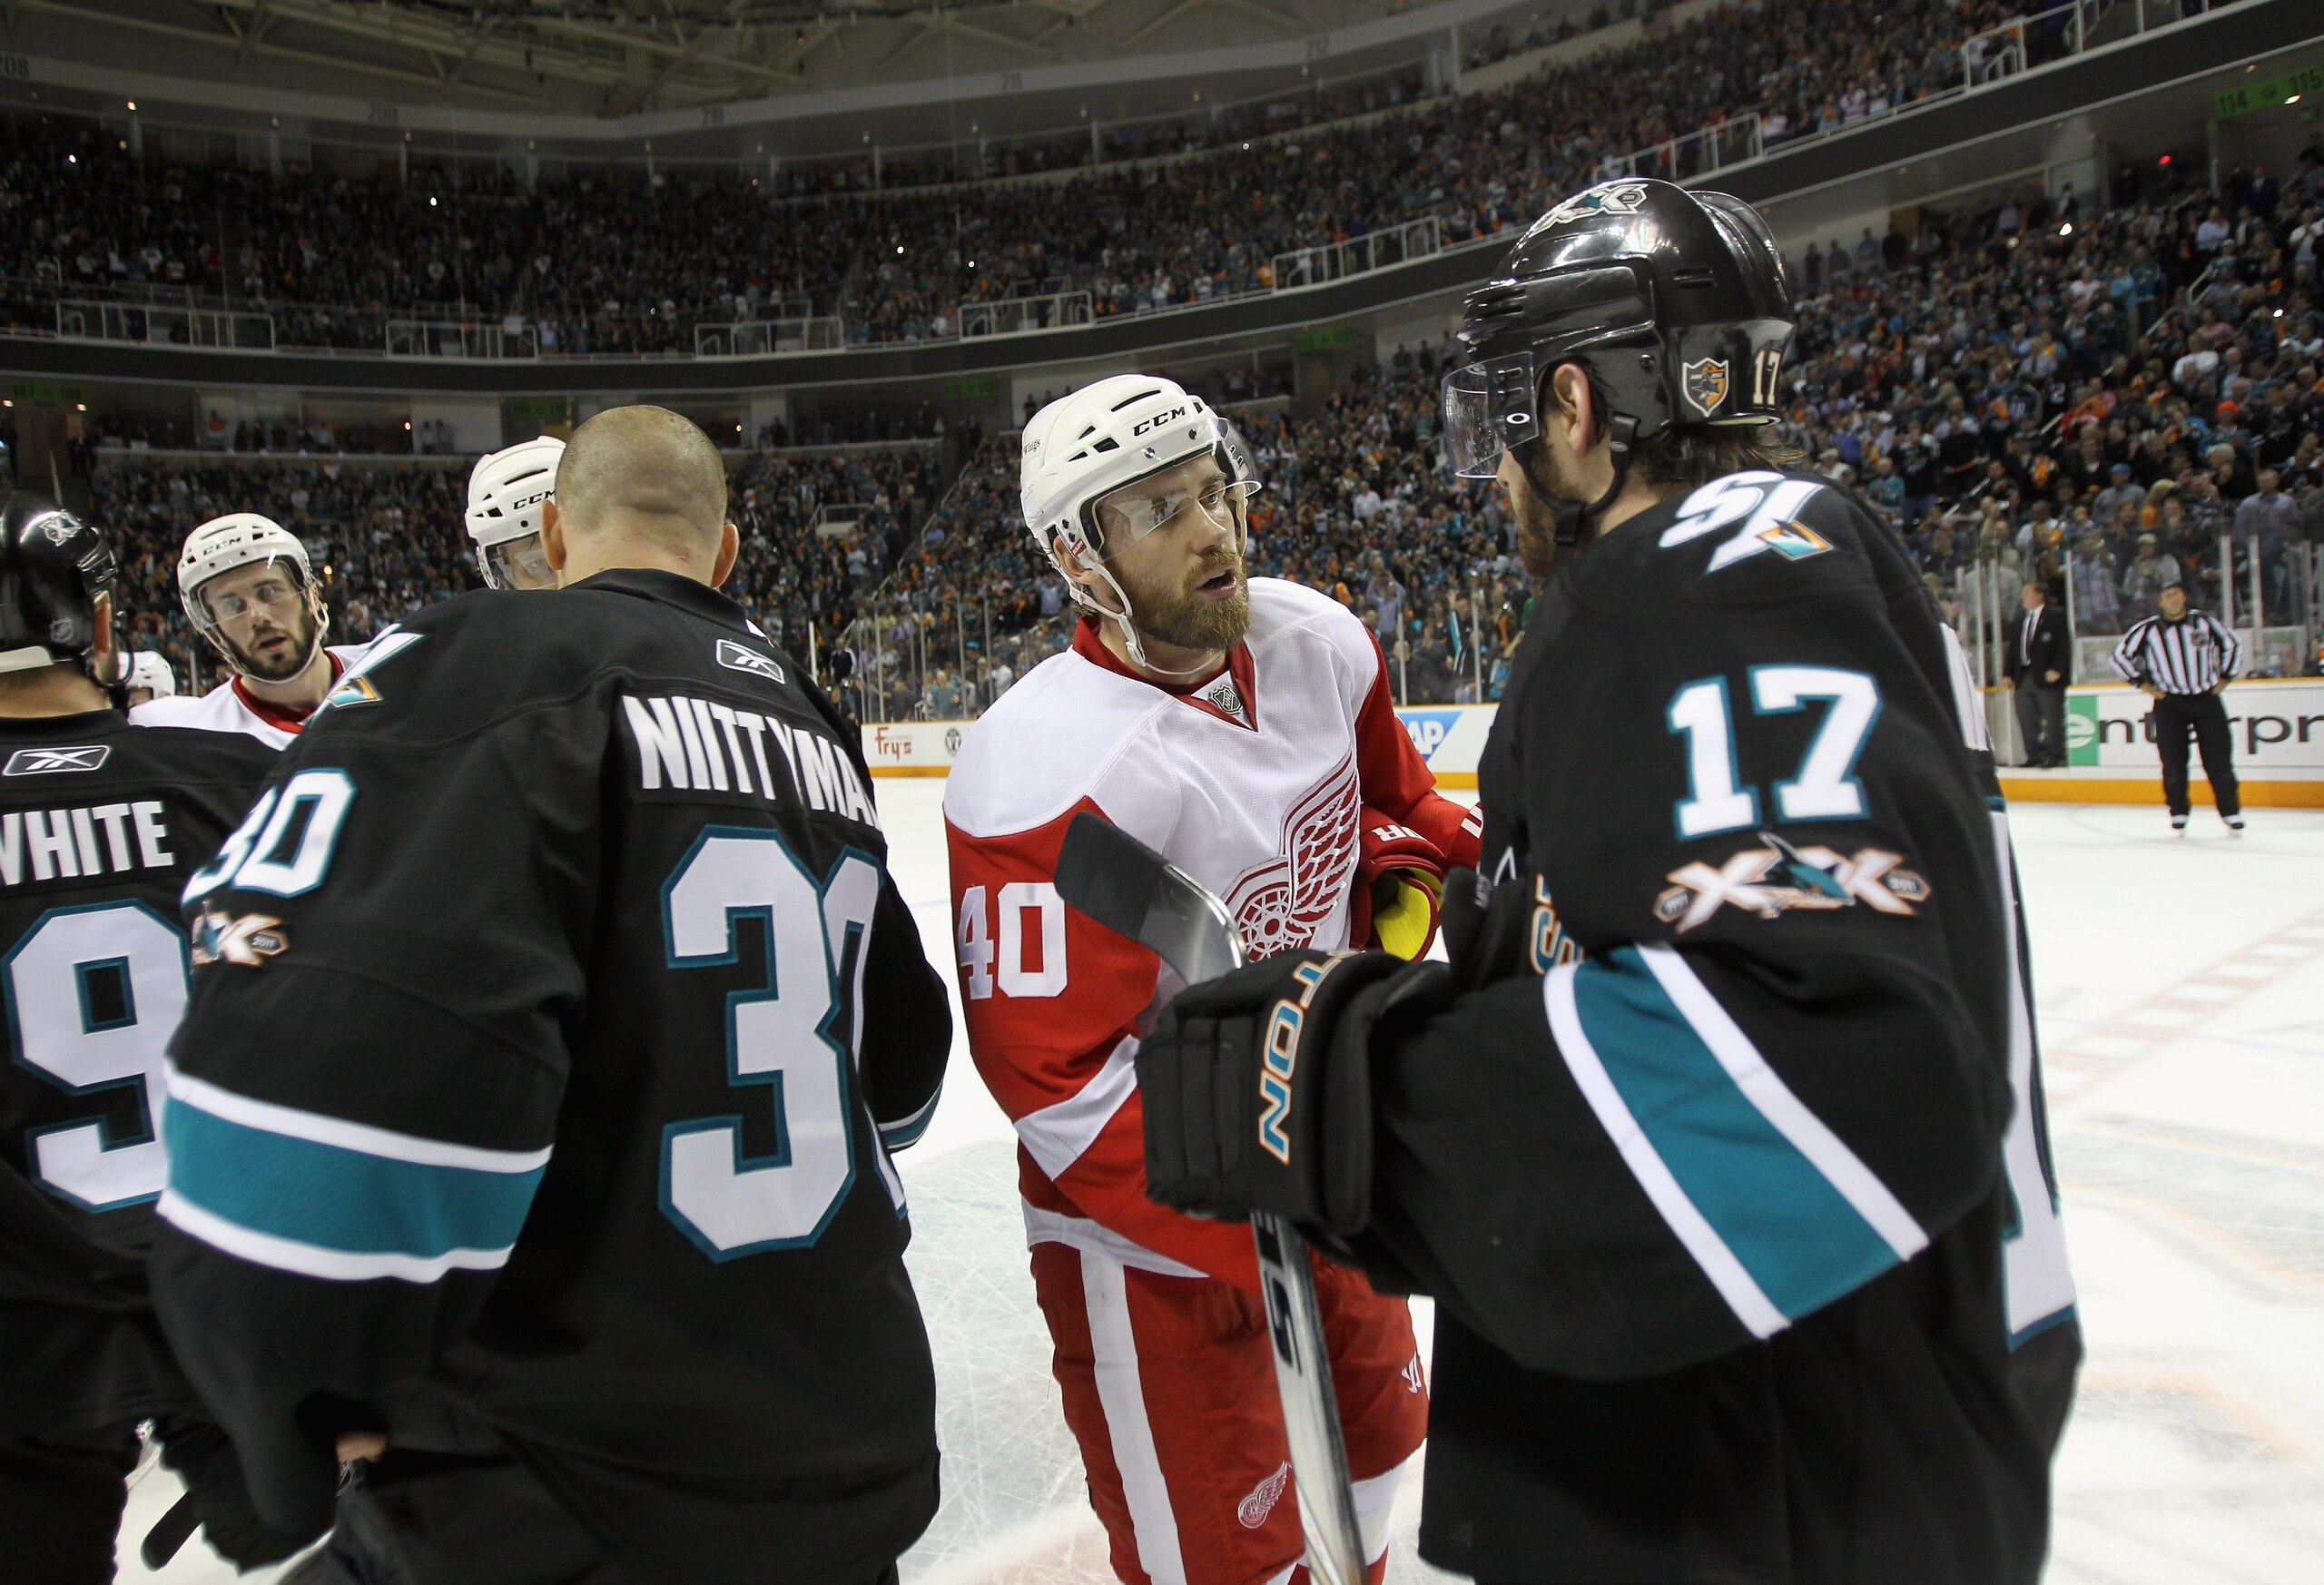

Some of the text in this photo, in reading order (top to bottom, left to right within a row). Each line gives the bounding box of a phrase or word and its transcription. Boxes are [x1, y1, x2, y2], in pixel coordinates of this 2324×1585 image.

[1752, 348, 1782, 406] 17
[1132, 406, 1186, 437] CCM
[513, 490, 556, 510] CCM
[202, 537, 242, 556] CCM
[875, 726, 912, 761] Fry's
[1408, 720, 1445, 755] AP
[1664, 662, 1886, 842] 17
[622, 694, 883, 833] NIITTYMA
[251, 935, 275, 950] 2011
[958, 881, 1068, 1000] 40
[0, 898, 194, 1215] 9
[657, 823, 909, 1265] 30
